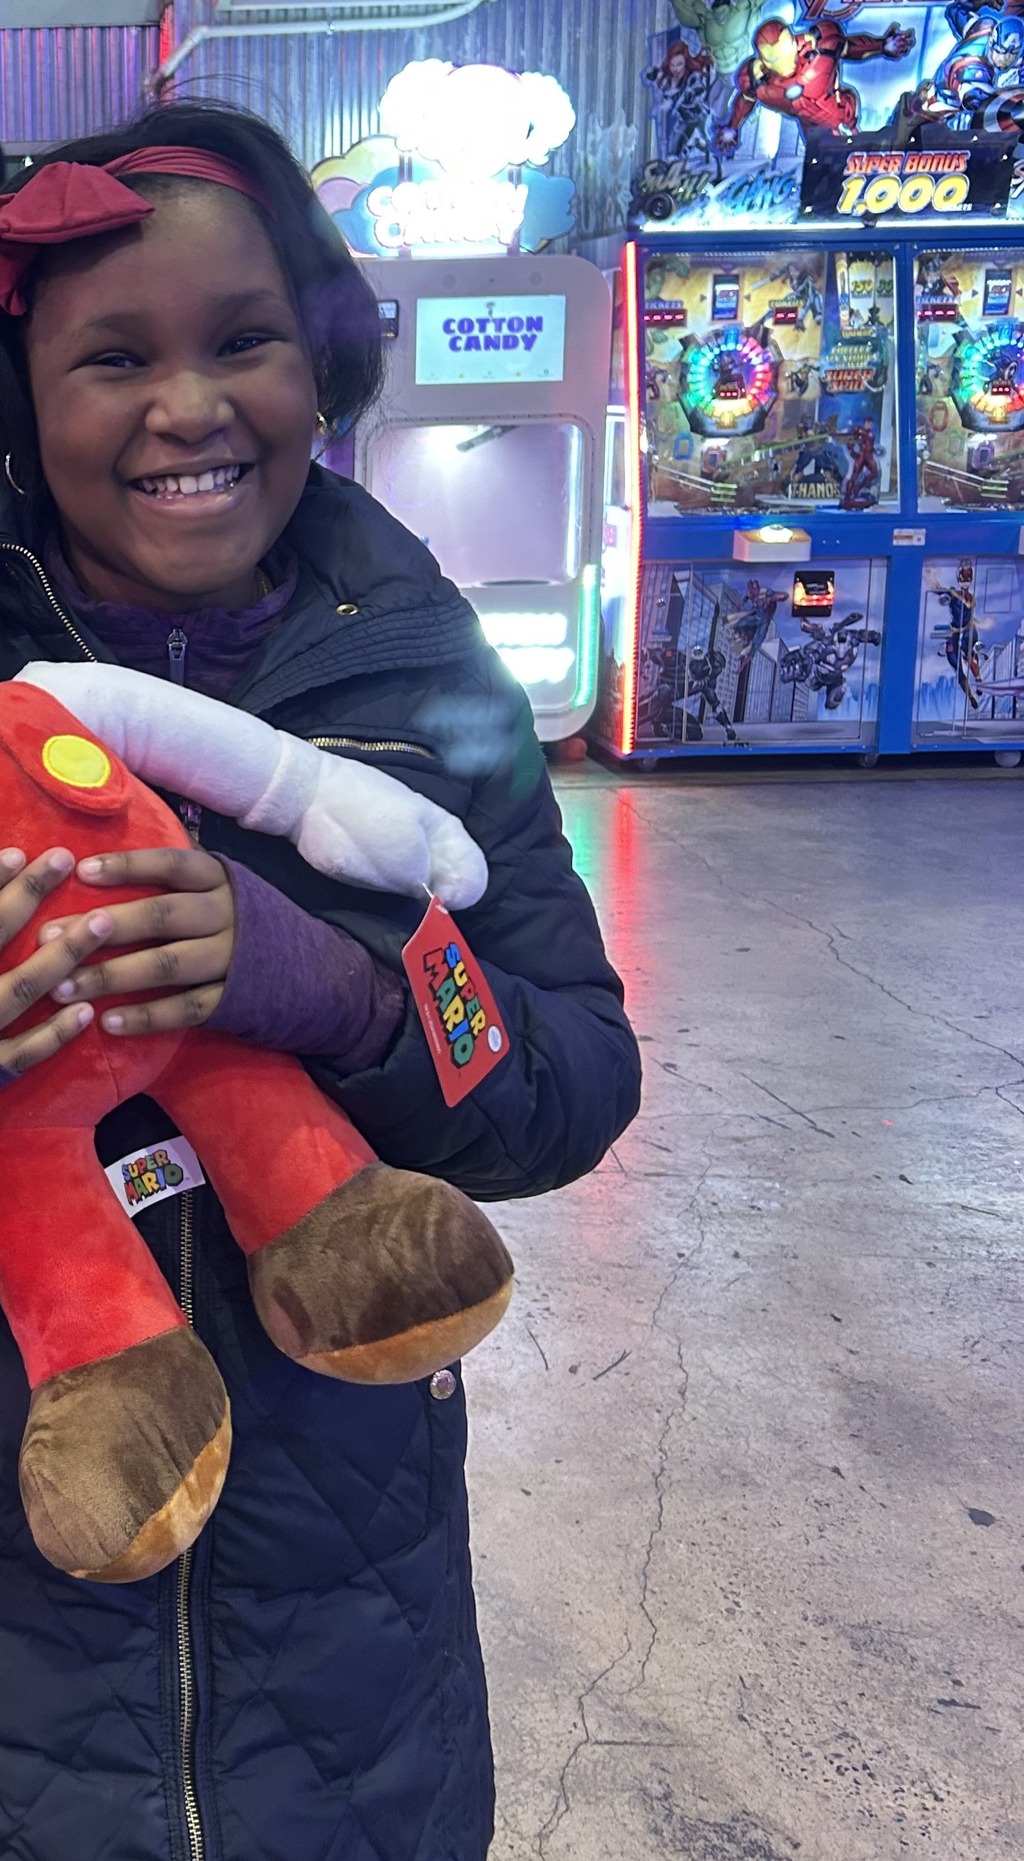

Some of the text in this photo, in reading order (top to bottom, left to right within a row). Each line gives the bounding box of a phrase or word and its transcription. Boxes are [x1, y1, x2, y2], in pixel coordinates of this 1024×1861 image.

[844, 150, 970, 175] SUPER BONUS
[836, 173, 970, 217] 1,000
[442, 316, 543, 335] COTTON
[448, 333, 538, 352] CANDY
[423, 947, 476, 1069] MARIO
[445, 942, 487, 1038] SUPER
[121, 1149, 171, 1183] SUPER
[124, 1163, 184, 1206] MARIO
